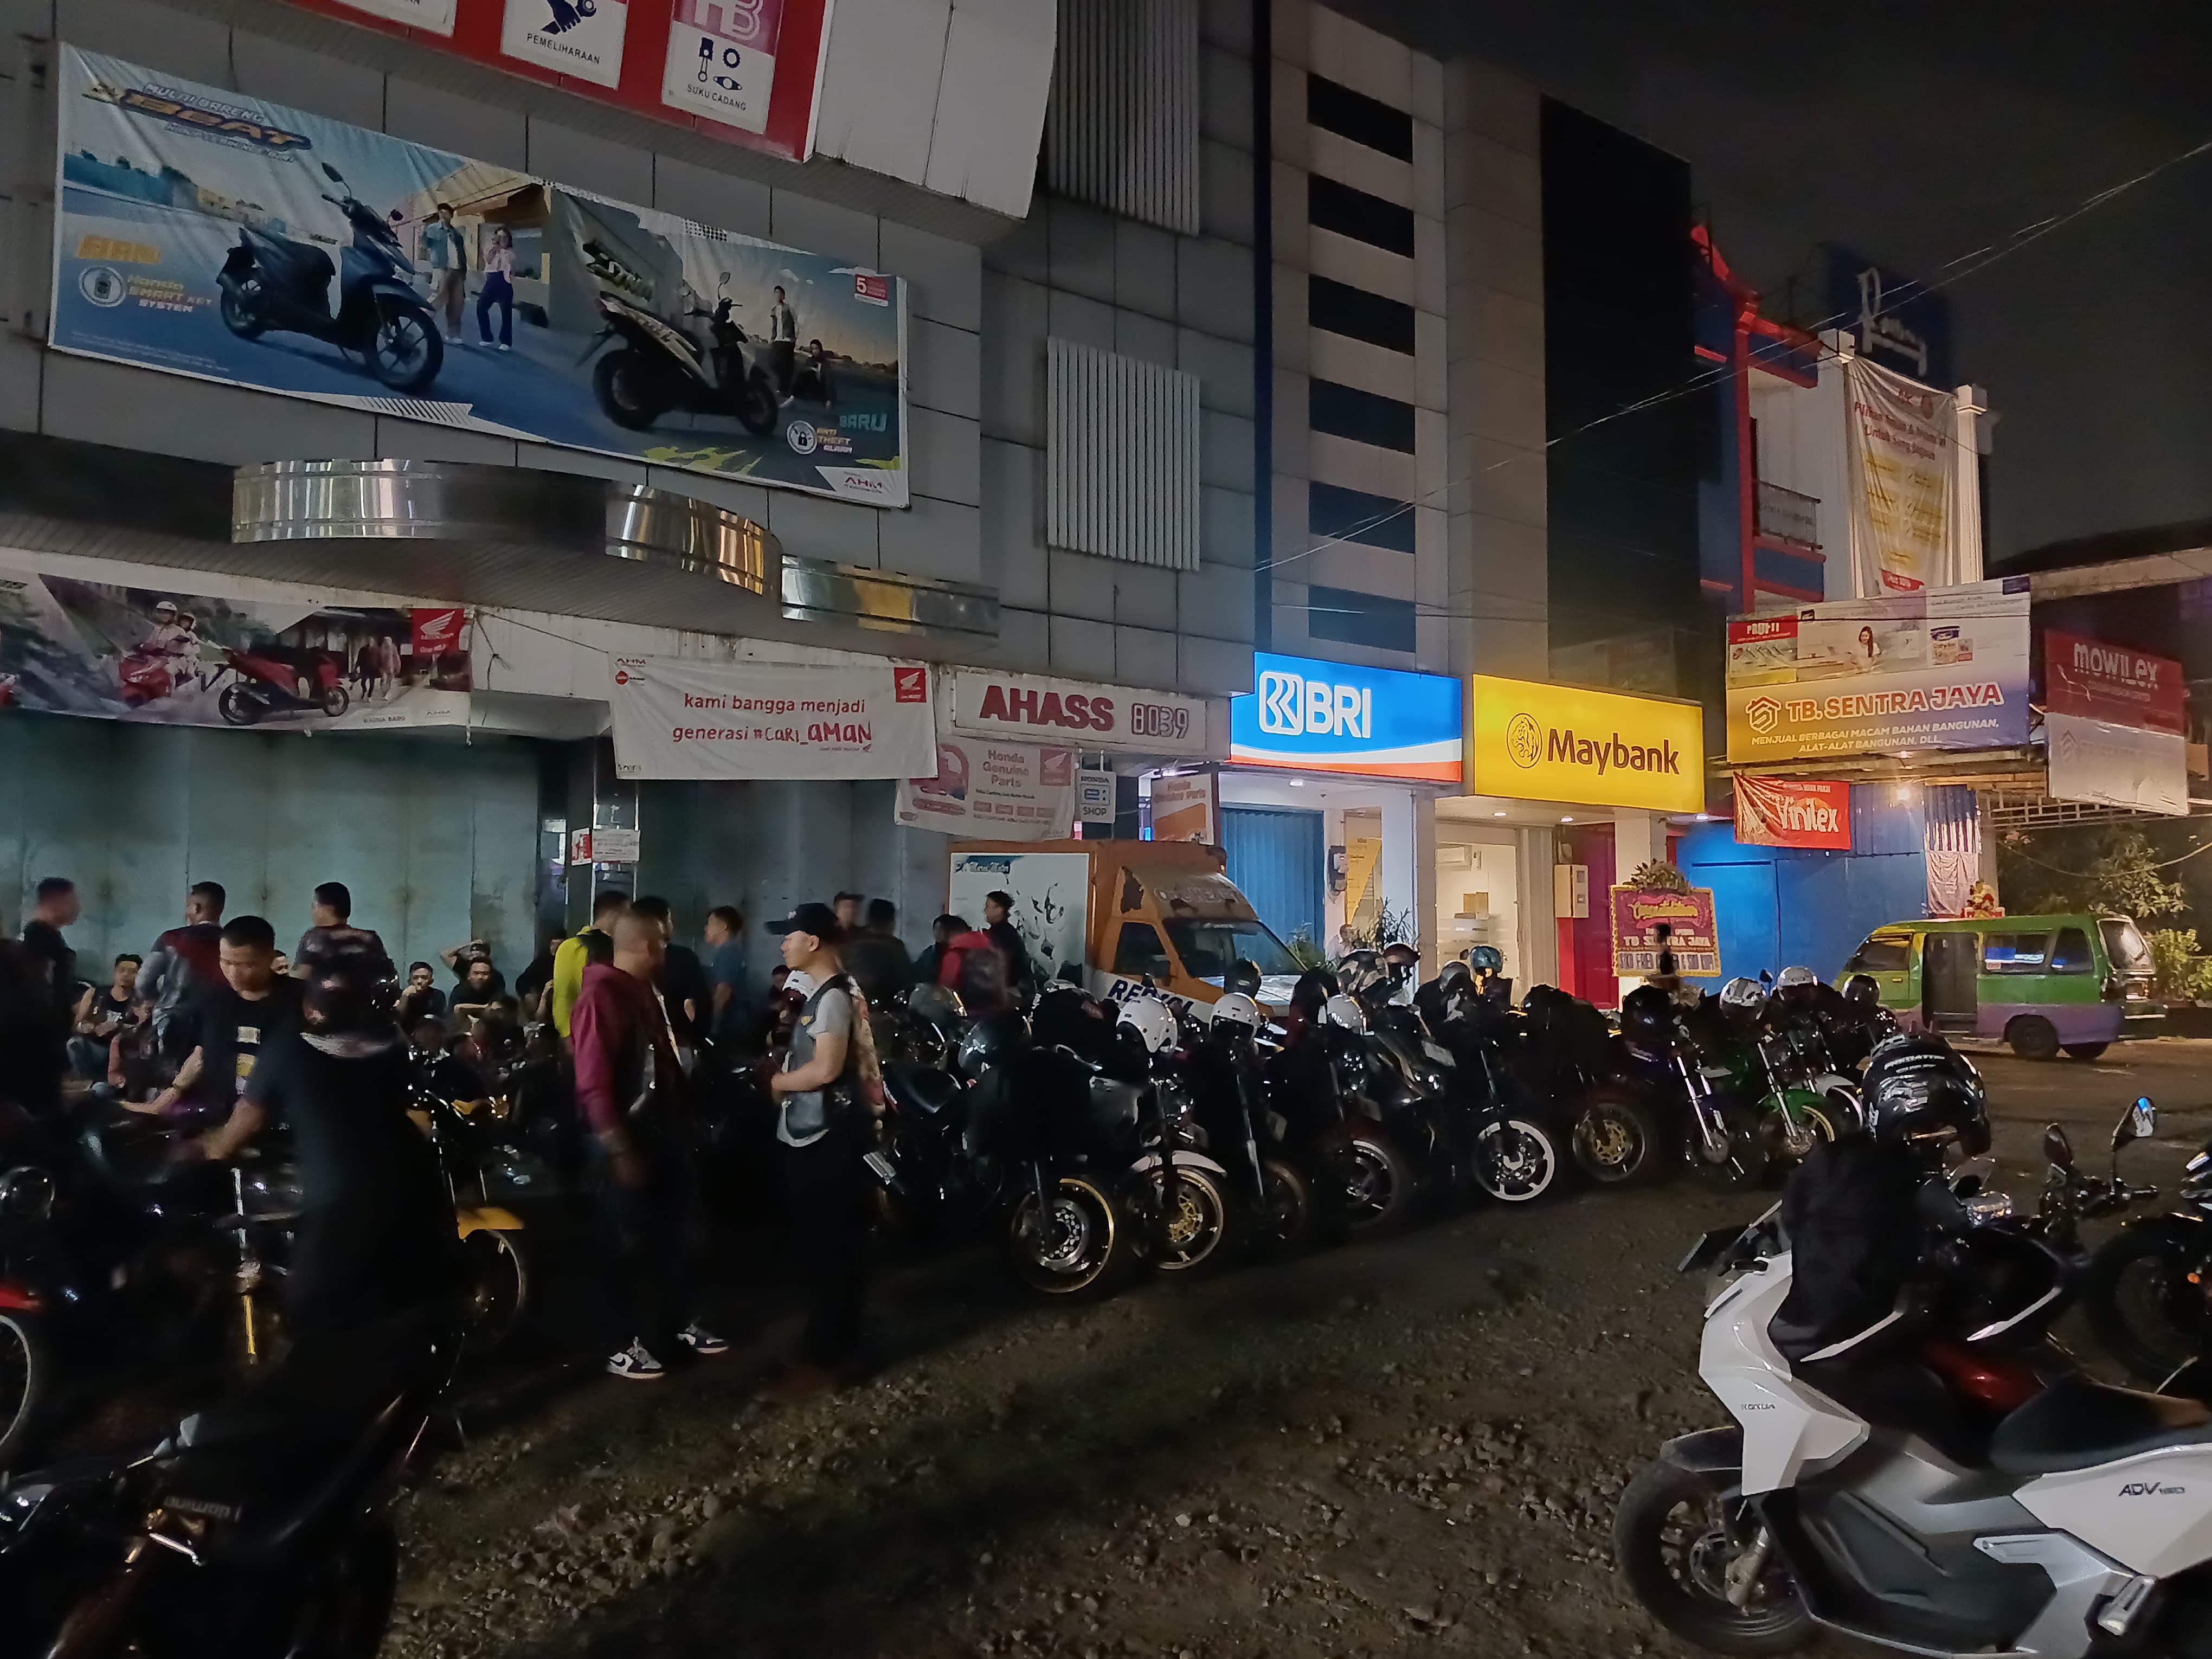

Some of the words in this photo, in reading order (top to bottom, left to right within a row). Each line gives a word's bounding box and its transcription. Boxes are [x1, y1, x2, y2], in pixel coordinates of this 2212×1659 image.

[527, 33, 600, 65] PEMELIHARAAN
[687, 84, 711, 100] SUKU
[712, 92, 747, 111] CADANG
[857, 277, 867, 293] 5
[839, 413, 888, 432] BARU
[684, 693, 726, 709] kami
[732, 695, 795, 715] bangga
[801, 698, 865, 716] menjadi
[1929, 681, 2004, 711] JAYA
[980, 685, 1115, 731] AHASS
[1306, 681, 1372, 738] BRI
[672, 726, 749, 742] generasi
[1751, 734, 1797, 745] MENJUAL
[1798, 730, 1849, 742] BERBAGAI
[1850, 726, 1890, 738] MACAM
[1892, 723, 1931, 735] BAHAN
[988, 749, 1025, 764] Honda
[1548, 728, 1680, 776] Maybank
[1799, 741, 1855, 753] ALAT-ALAT
[991, 775, 1021, 788] Parts
[1083, 807, 1107, 816] SHOP
[1775, 795, 1840, 833] Vinilex
[2118, 1482, 2161, 1497] ADV
